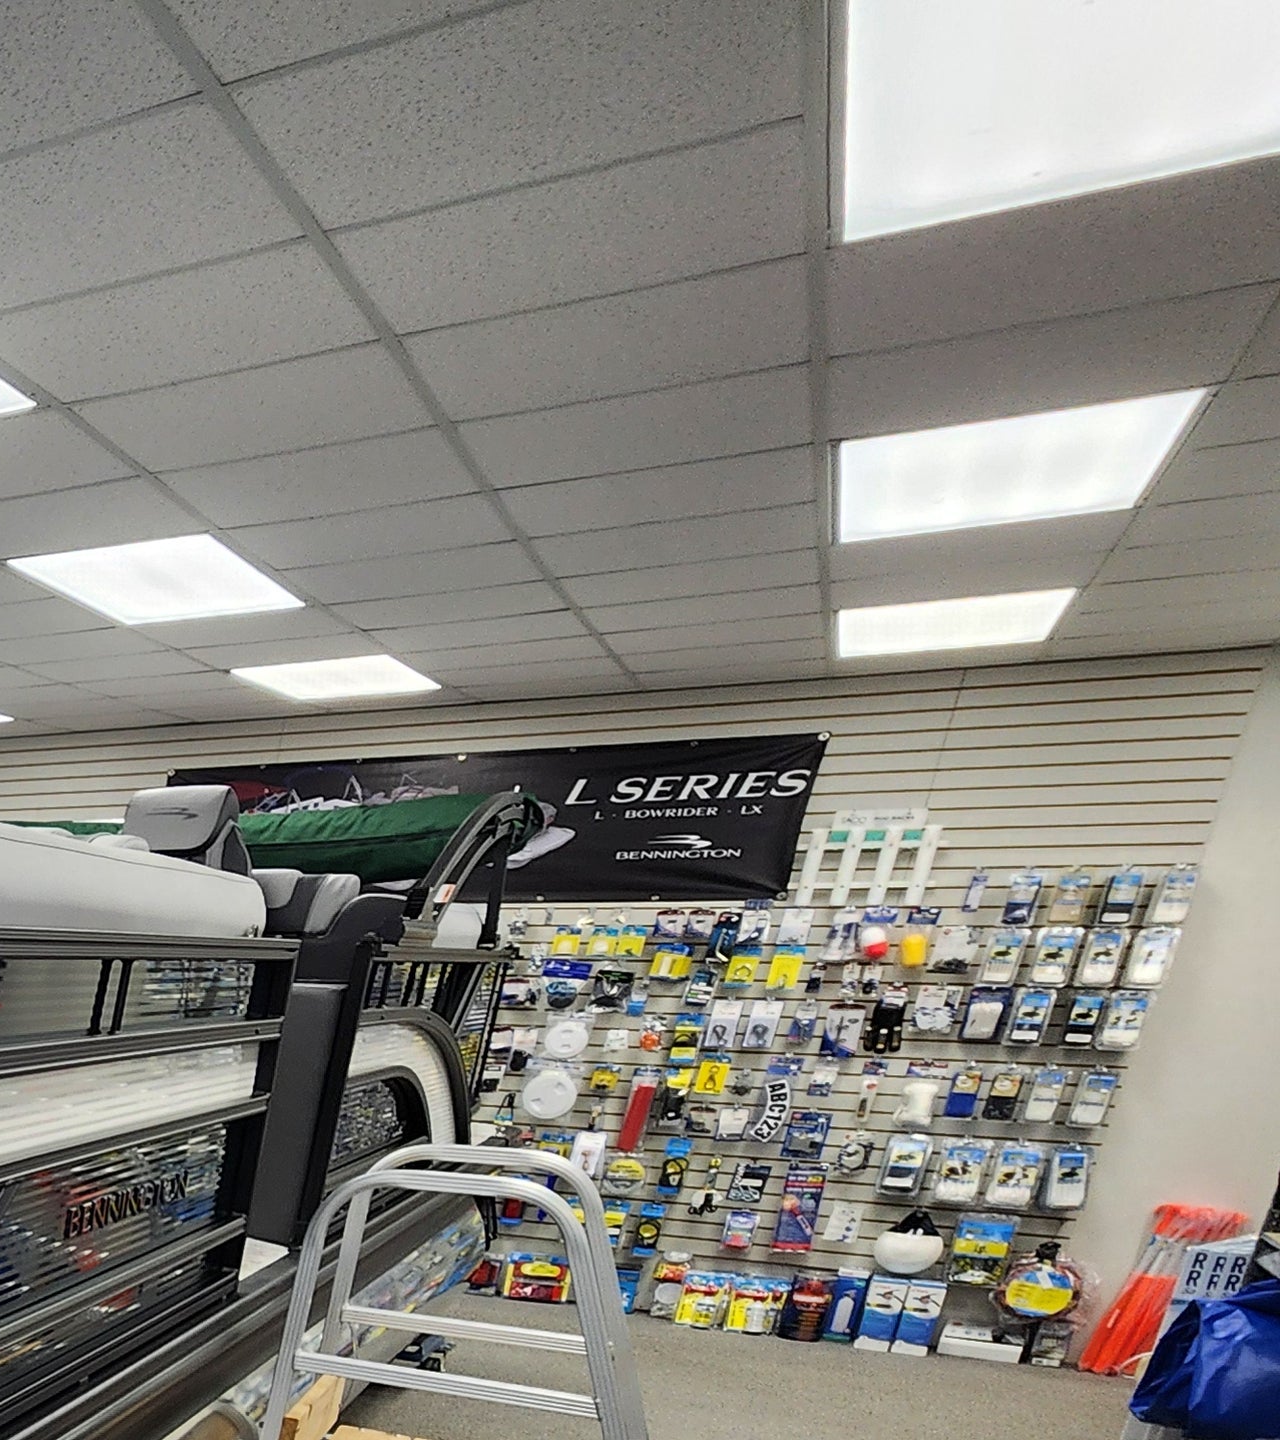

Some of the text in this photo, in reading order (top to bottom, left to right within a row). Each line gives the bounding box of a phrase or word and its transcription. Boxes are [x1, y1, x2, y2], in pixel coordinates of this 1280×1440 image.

[564, 769, 812, 806] L SERIES
[594, 804, 764, 820] L BOWRIDER LX
[615, 848, 742, 861] BENNINGTON
[753, 1082, 788, 1139] ABC123
[63, 1170, 189, 1239] BENNINGTON
